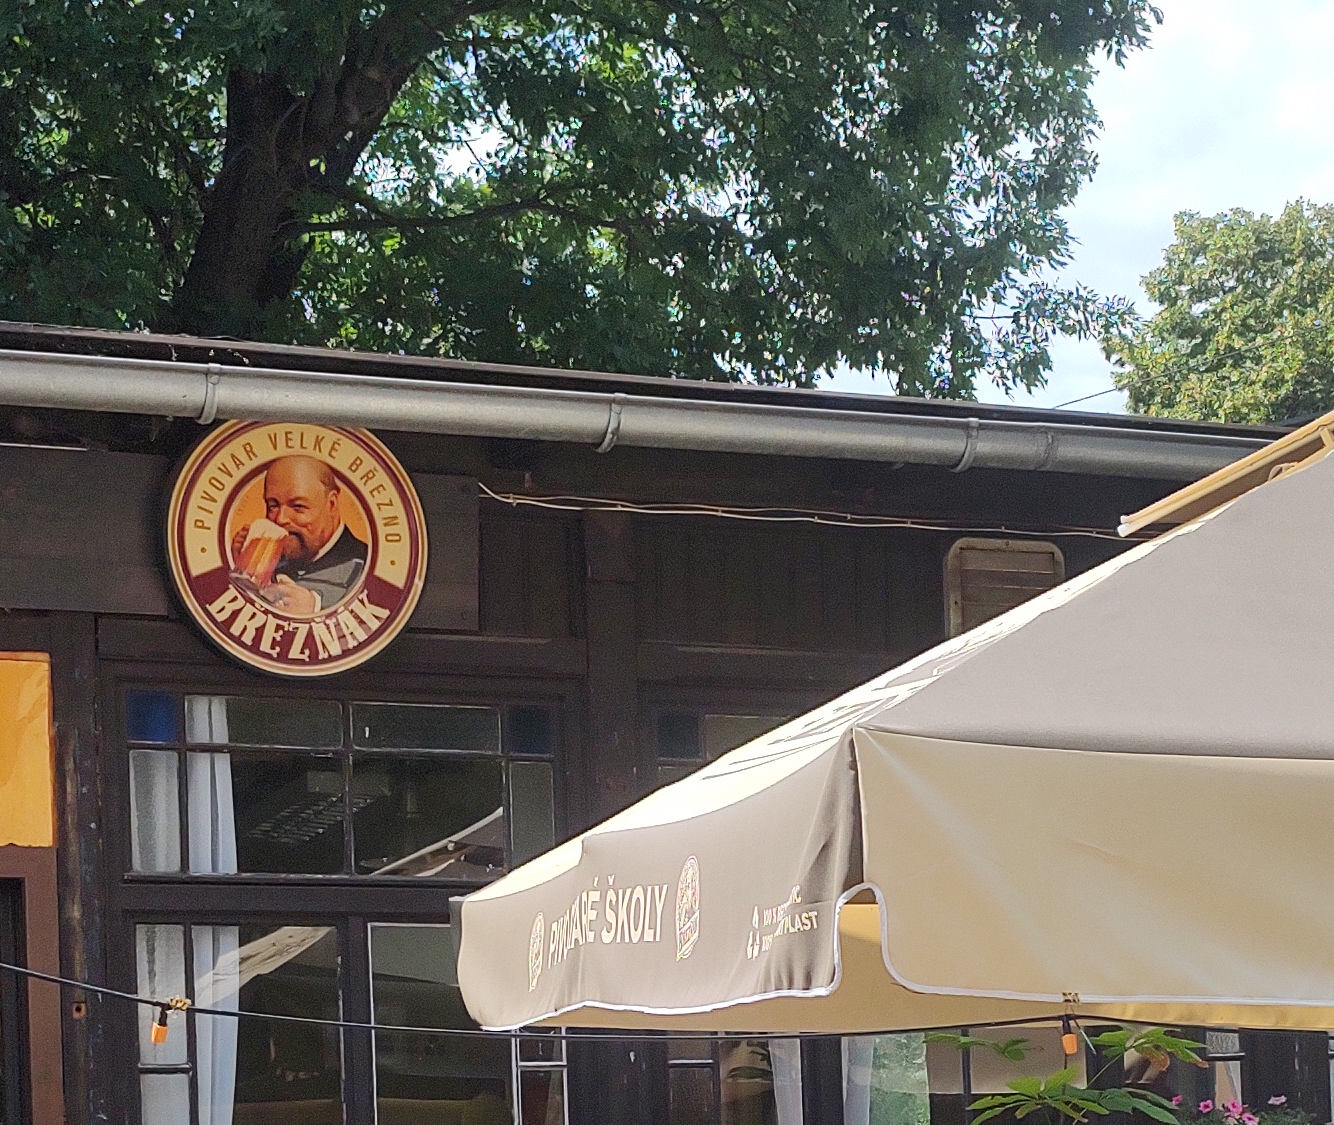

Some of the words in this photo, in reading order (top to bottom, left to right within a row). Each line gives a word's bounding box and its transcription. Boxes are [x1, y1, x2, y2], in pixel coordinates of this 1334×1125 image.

[194, 441, 258, 531] PIVOVAR
[267, 430, 342, 459] VELKÉ
[347, 456, 403, 544] BŘEZNO
[206, 584, 391, 662] BŘEZŇÁK
[601, 874, 668, 944] ŠKOLY
